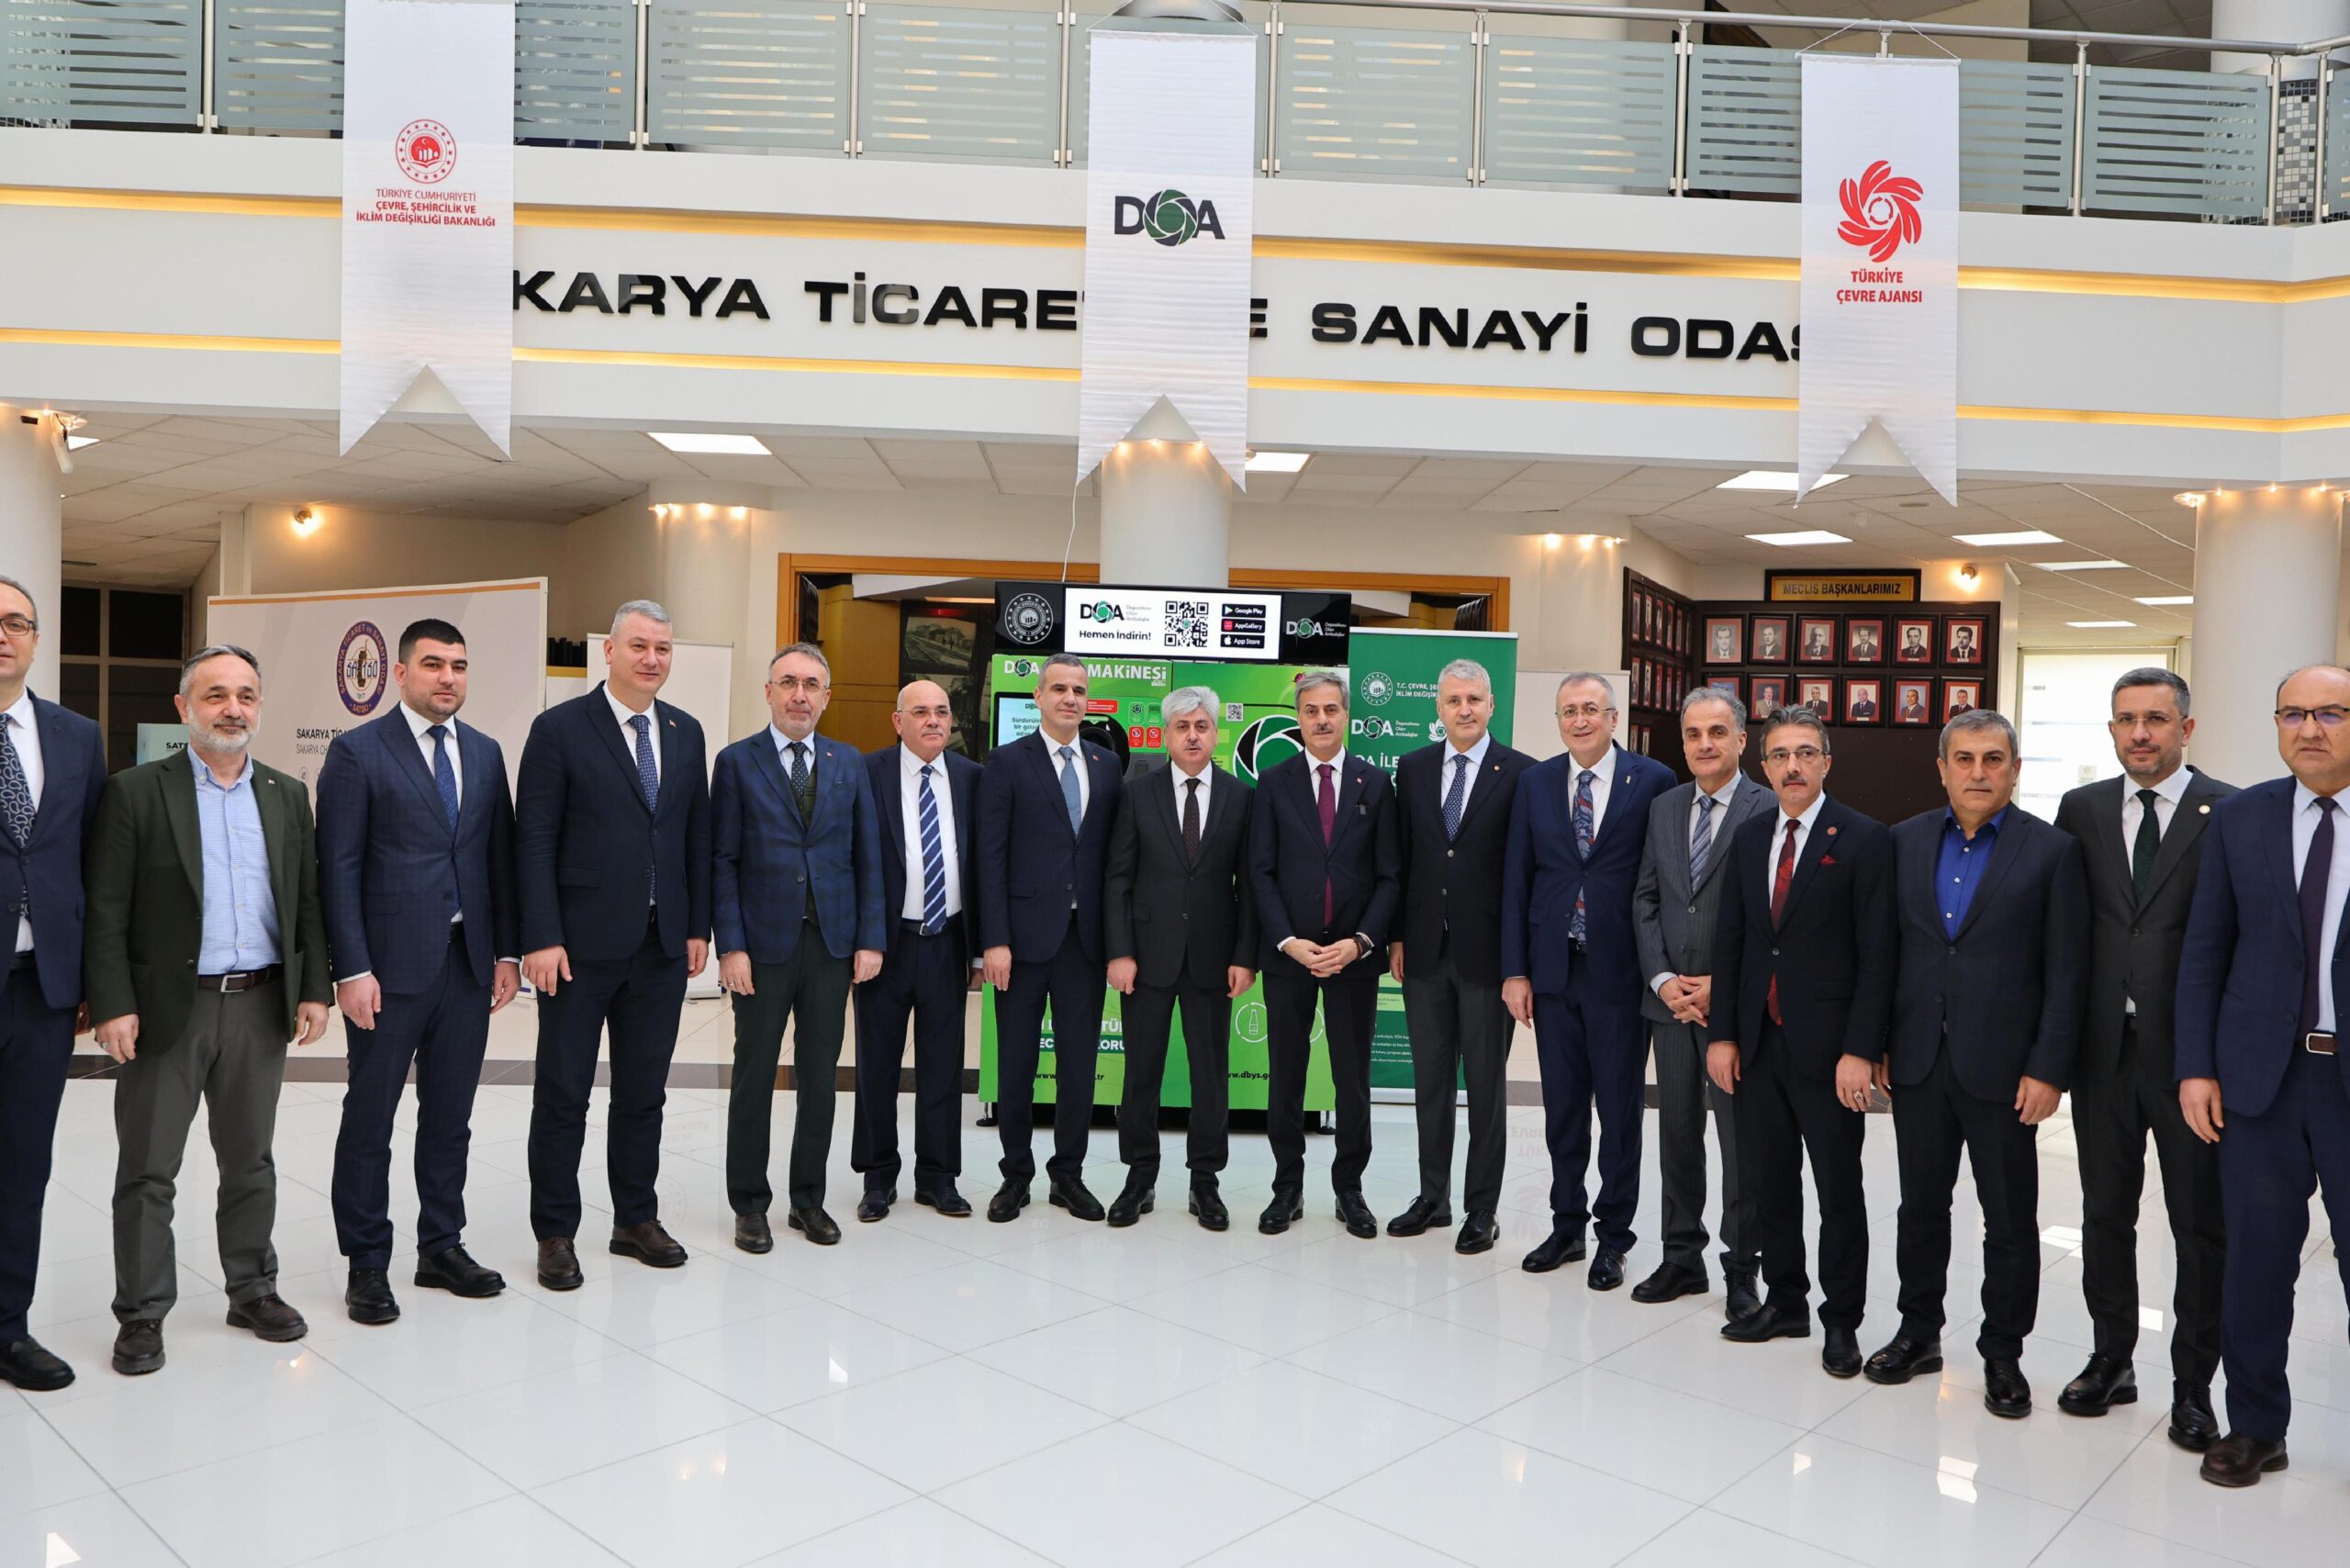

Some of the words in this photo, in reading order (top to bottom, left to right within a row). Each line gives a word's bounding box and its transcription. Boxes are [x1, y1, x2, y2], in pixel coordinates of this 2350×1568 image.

[375, 188, 412, 199] TÜRKİYE
[415, 189, 476, 202] CUMHURİYETİ
[375, 201, 408, 212] ÇEVRE,
[411, 202, 462, 213] ŞEHİRCİLİK
[464, 205, 476, 214] VE
[356, 210, 383, 221] İKLİM
[386, 212, 442, 225] DEĞİŞİKLİĞİ
[443, 216, 496, 227] BAKANLIĞI
[1851, 267, 1903, 283] TÜRKİYE
[1837, 289, 1875, 304] ÇEVRE
[1878, 290, 1922, 303] AJANSI
[804, 272, 1084, 330] TİCARE
[1311, 301, 1587, 353] SANAYİ
[1630, 316, 1800, 362] ODA
[1821, 583, 1901, 597] BAŞKANLARIMIZ
[1235, 622, 1263, 631] AppGallery
[1080, 630, 1114, 639] Hemen
[1116, 630, 1151, 641] İndirin!
[297, 728, 330, 740] SAKARYA
